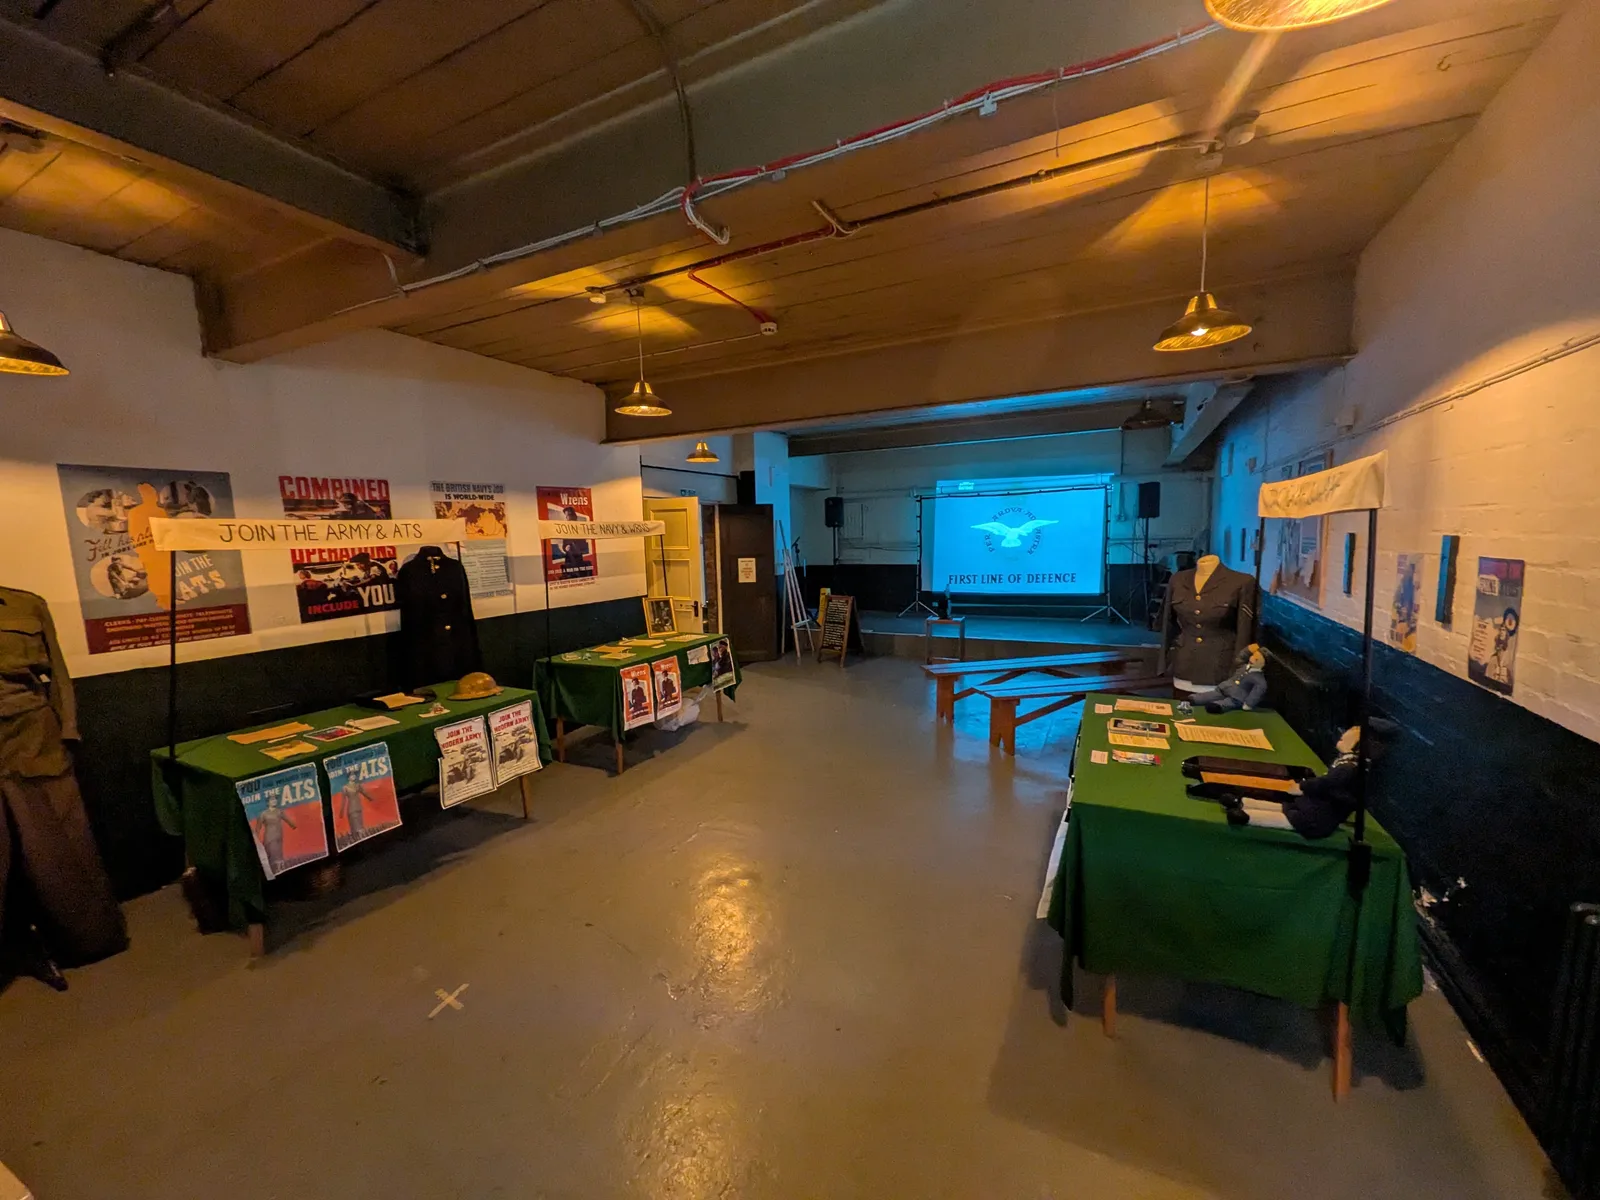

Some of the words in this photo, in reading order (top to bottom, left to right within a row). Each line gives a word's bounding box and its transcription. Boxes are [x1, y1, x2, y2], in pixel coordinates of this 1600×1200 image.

[279, 476, 390, 500] COMBINED
[560, 493, 588, 505] Wrens
[218, 523, 276, 542] JOIN
[277, 524, 320, 542] THE
[326, 523, 371, 540] ARMY
[376, 525, 388, 539] &
[392, 524, 423, 539] ATS
[555, 523, 578, 535] JOIN
[582, 523, 598, 535] THE
[600, 524, 619, 534] NAVY
[621, 526, 628, 534] &
[176, 560, 193, 577] OIN
[190, 554, 214, 570] THE
[948, 574, 978, 584] FIRST
[981, 574, 1004, 584] LINE
[1008, 574, 1022, 583] OF
[1026, 573, 1076, 583] DEFENCE
[308, 600, 360, 615] INCLUDE
[358, 584, 396, 608] YOU
[499, 712, 510, 722] JOIN
[512, 710, 521, 718] THE
[494, 720, 514, 732] MODERN
[515, 716, 529, 724] ARMY
[446, 728, 461, 739] JOIN
[462, 725, 472, 734] THE
[441, 737, 464, 749] MODERN
[465, 732, 482, 741] ARMY
[346, 764, 359, 773] THE
[264, 788, 280, 798] THE
